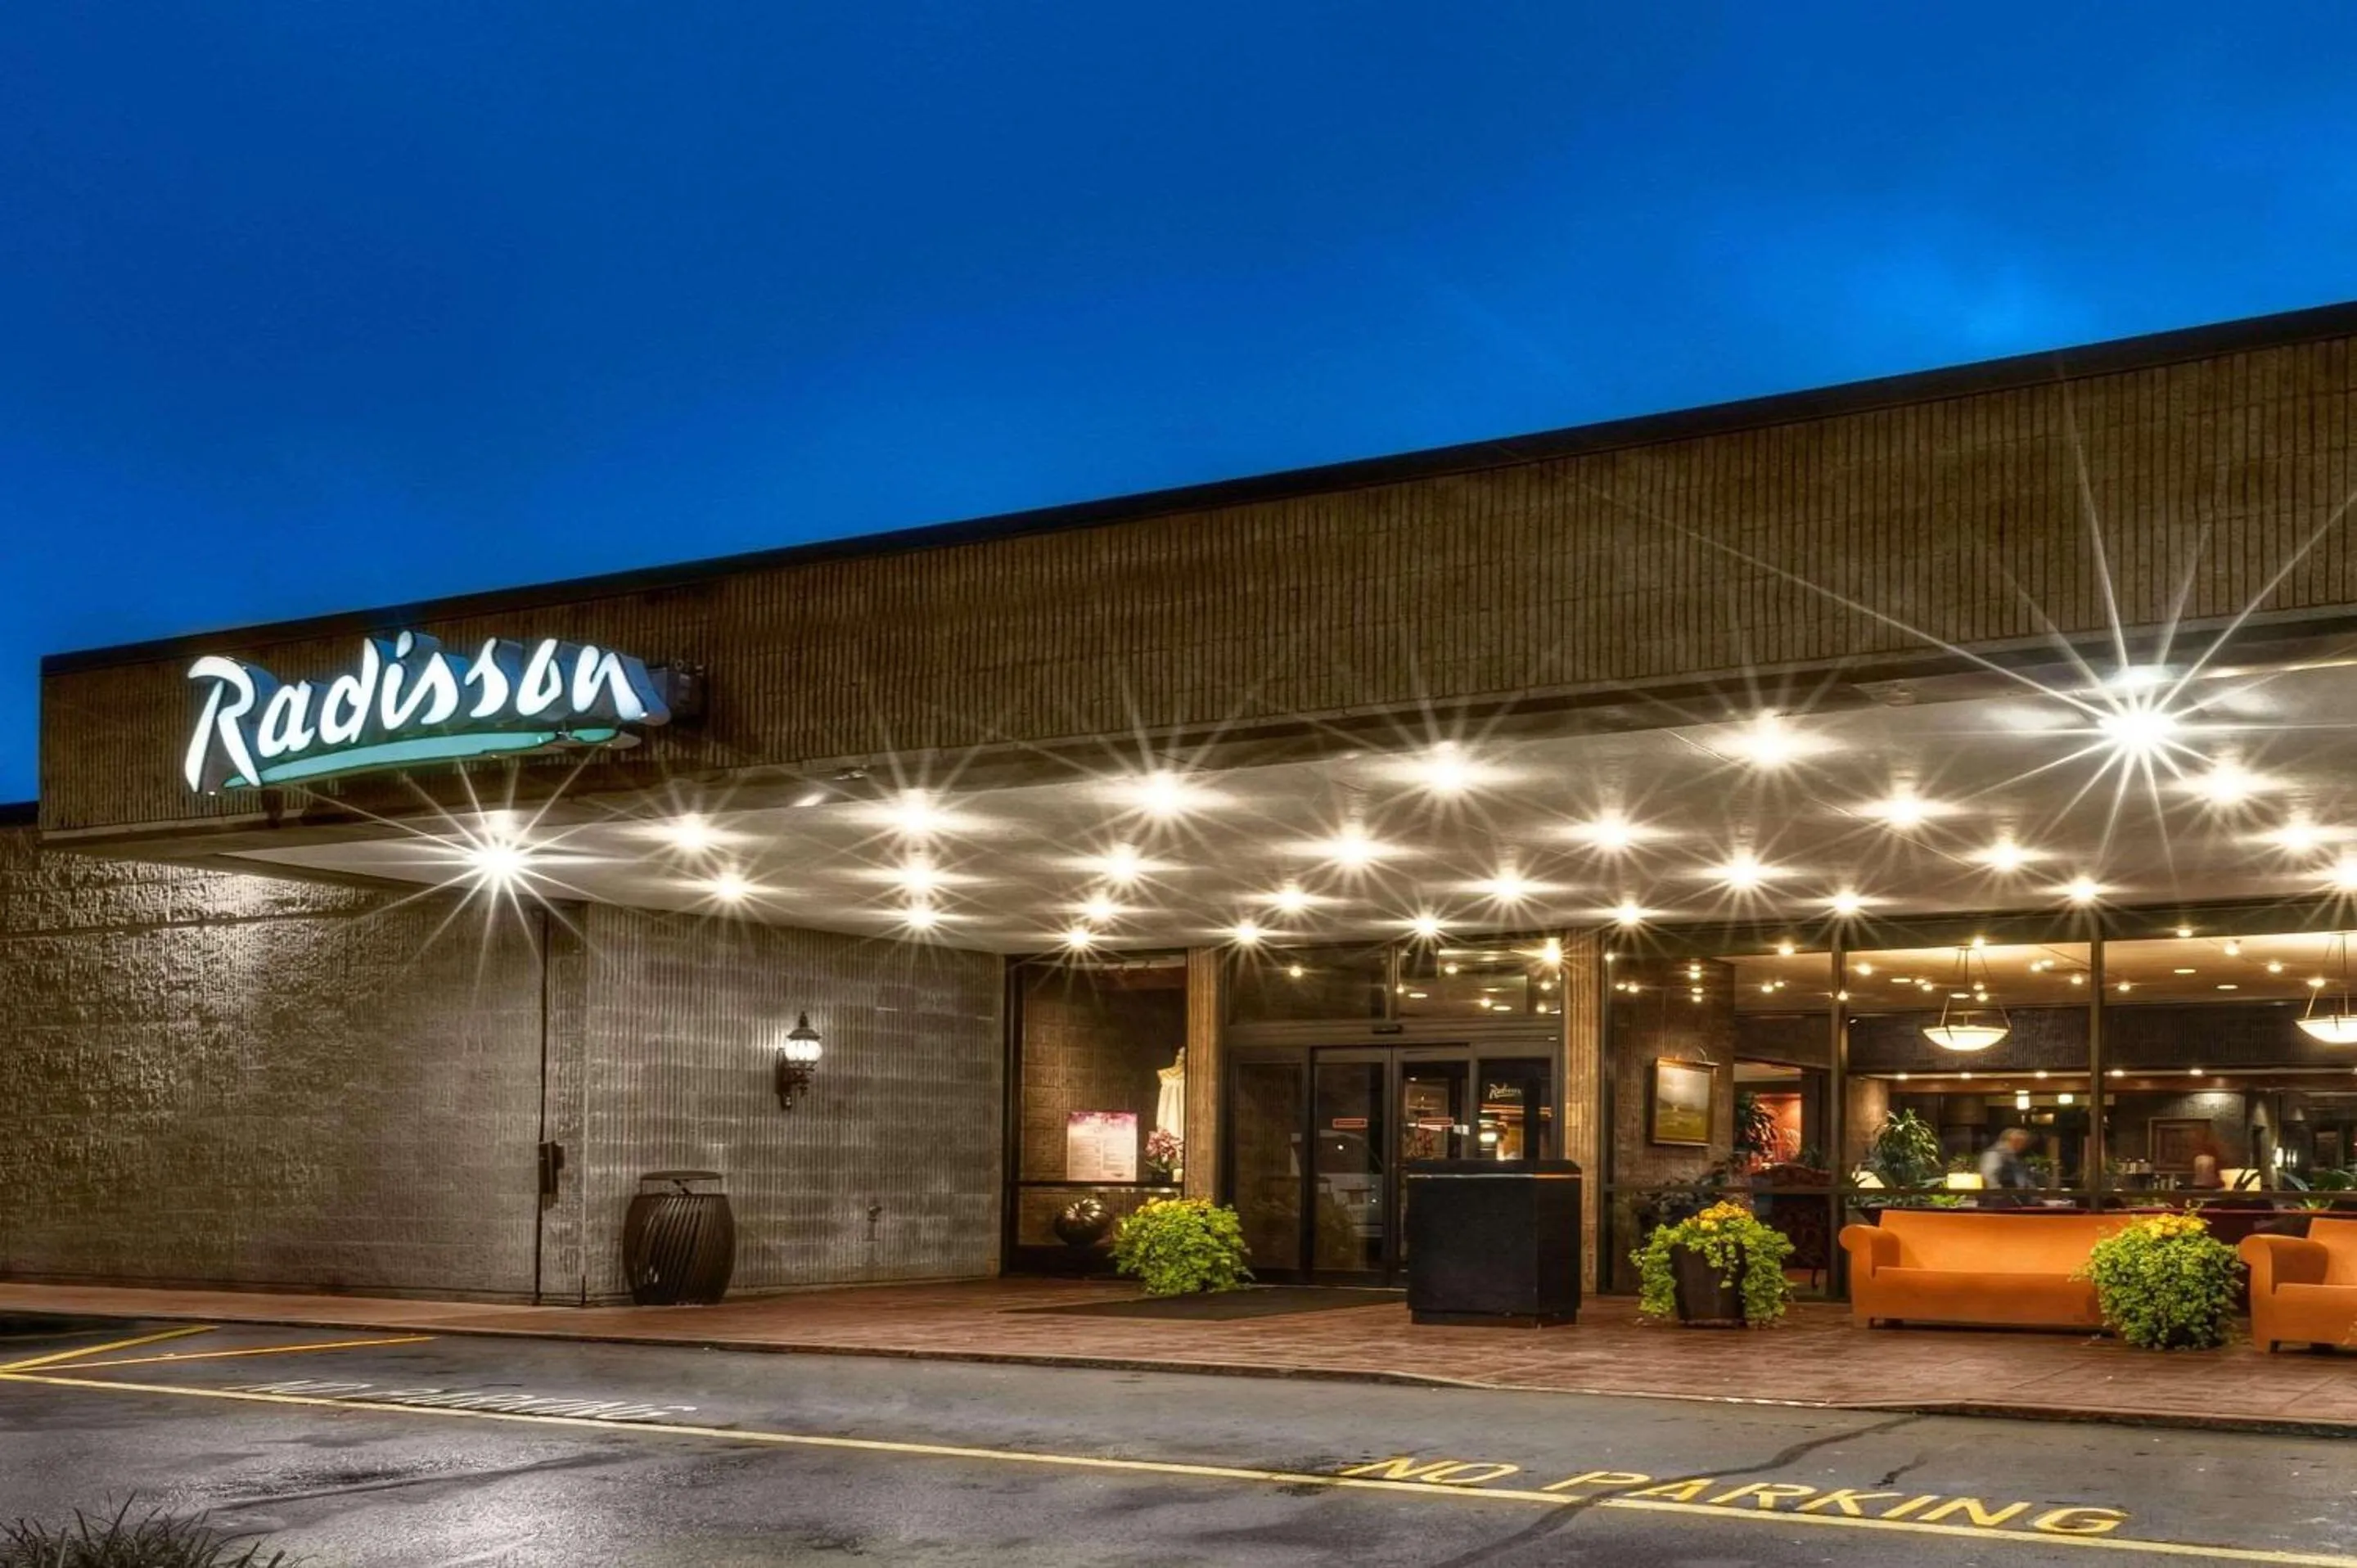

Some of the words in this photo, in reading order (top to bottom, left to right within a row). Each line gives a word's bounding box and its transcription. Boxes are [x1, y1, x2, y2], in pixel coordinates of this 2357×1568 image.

[185, 630, 649, 792] Radisson
[1340, 1457, 1519, 1484] NO
[1542, 1471, 2128, 1533] PARKING
